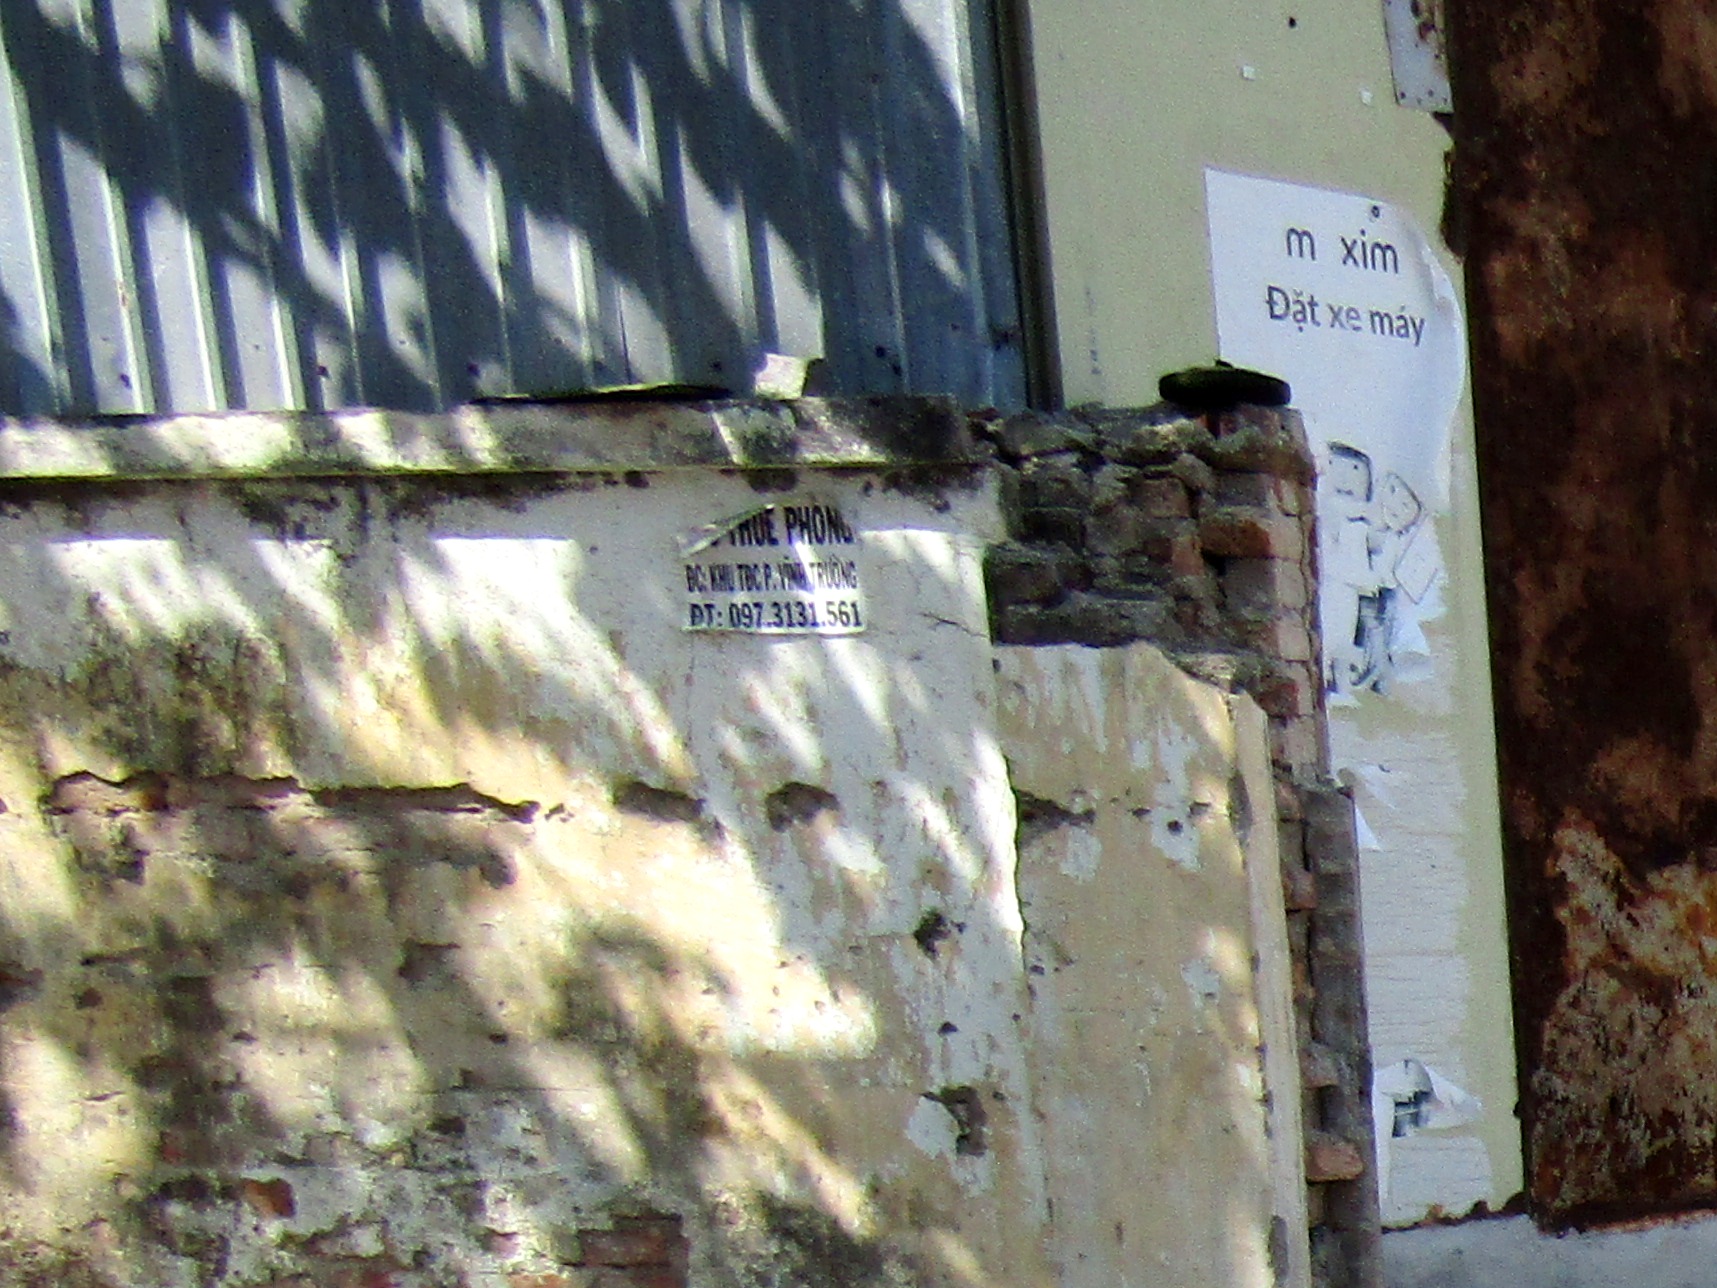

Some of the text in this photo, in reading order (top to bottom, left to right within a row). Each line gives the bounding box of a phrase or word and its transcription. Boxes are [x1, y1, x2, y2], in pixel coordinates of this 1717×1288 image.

[1265, 285, 1425, 347] Đặt xe máy
[729, 601, 863, 628] 097.3131.561
